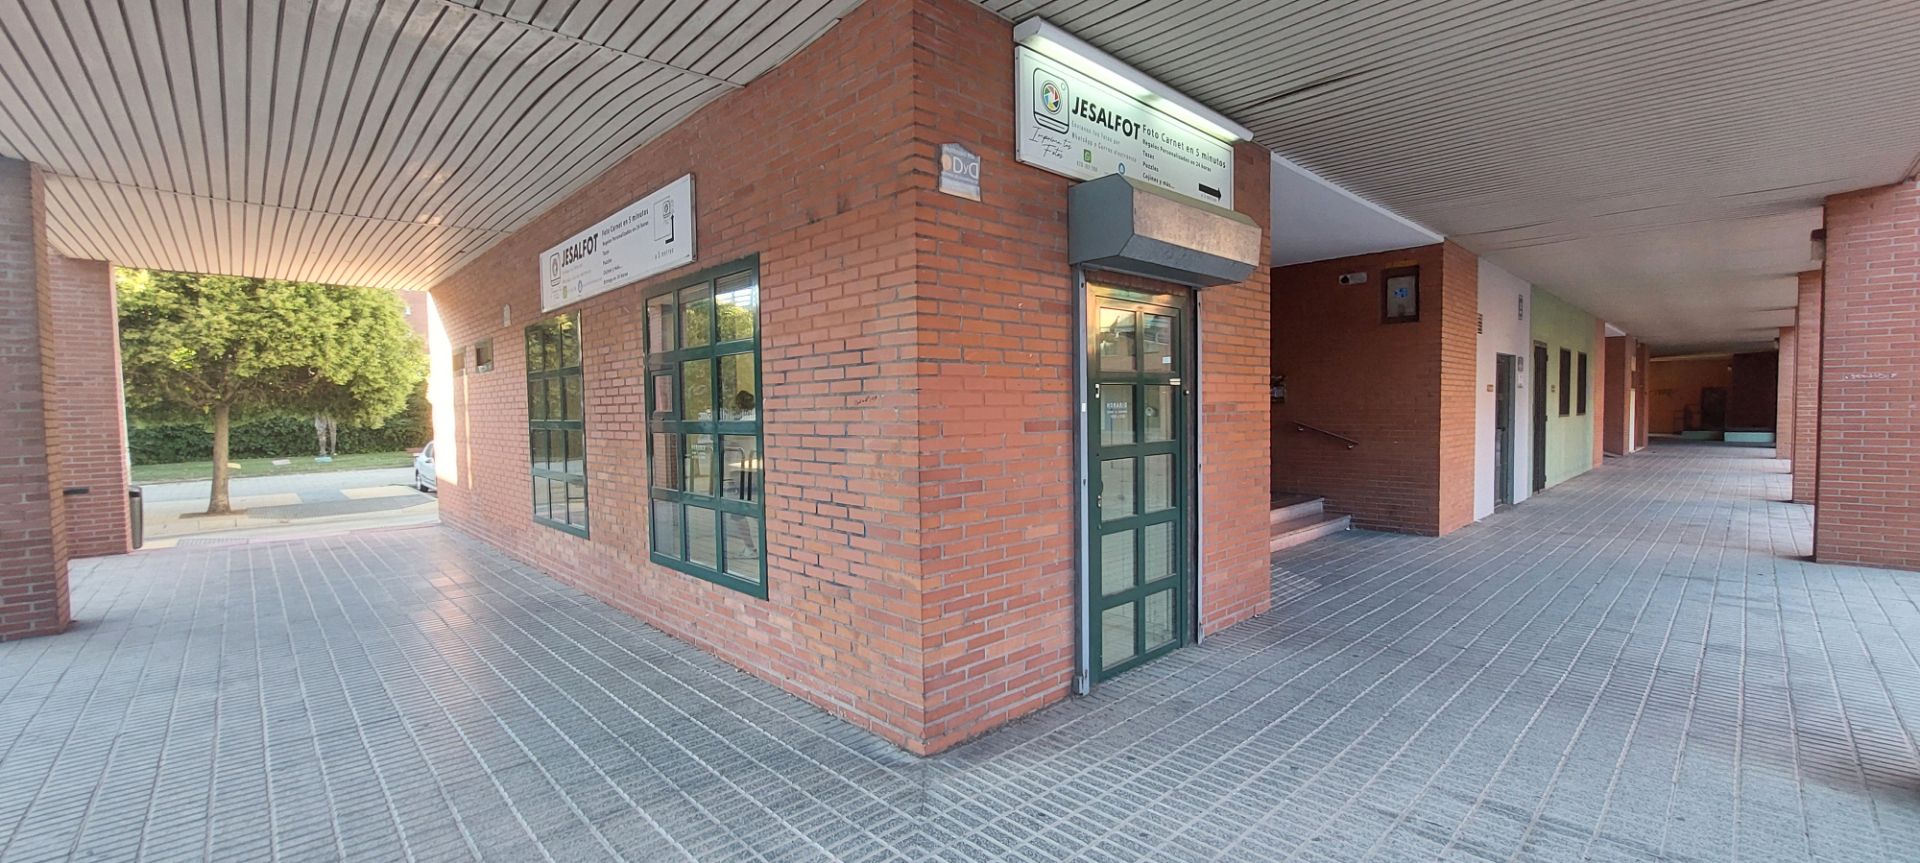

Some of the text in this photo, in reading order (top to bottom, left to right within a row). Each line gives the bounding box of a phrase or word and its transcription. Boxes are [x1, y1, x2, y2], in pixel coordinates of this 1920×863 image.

[1071, 96, 1141, 140] JESALFOT
[1142, 124, 1226, 169] Foto Carnet en 5 minutos
[1142, 138, 1160, 151] Regalos
[1160, 146, 1190, 163] Personalizados
[1201, 164, 1211, 172] horas
[1142, 161, 1159, 173] Puzzles
[561, 232, 599, 268] JESALFOT
